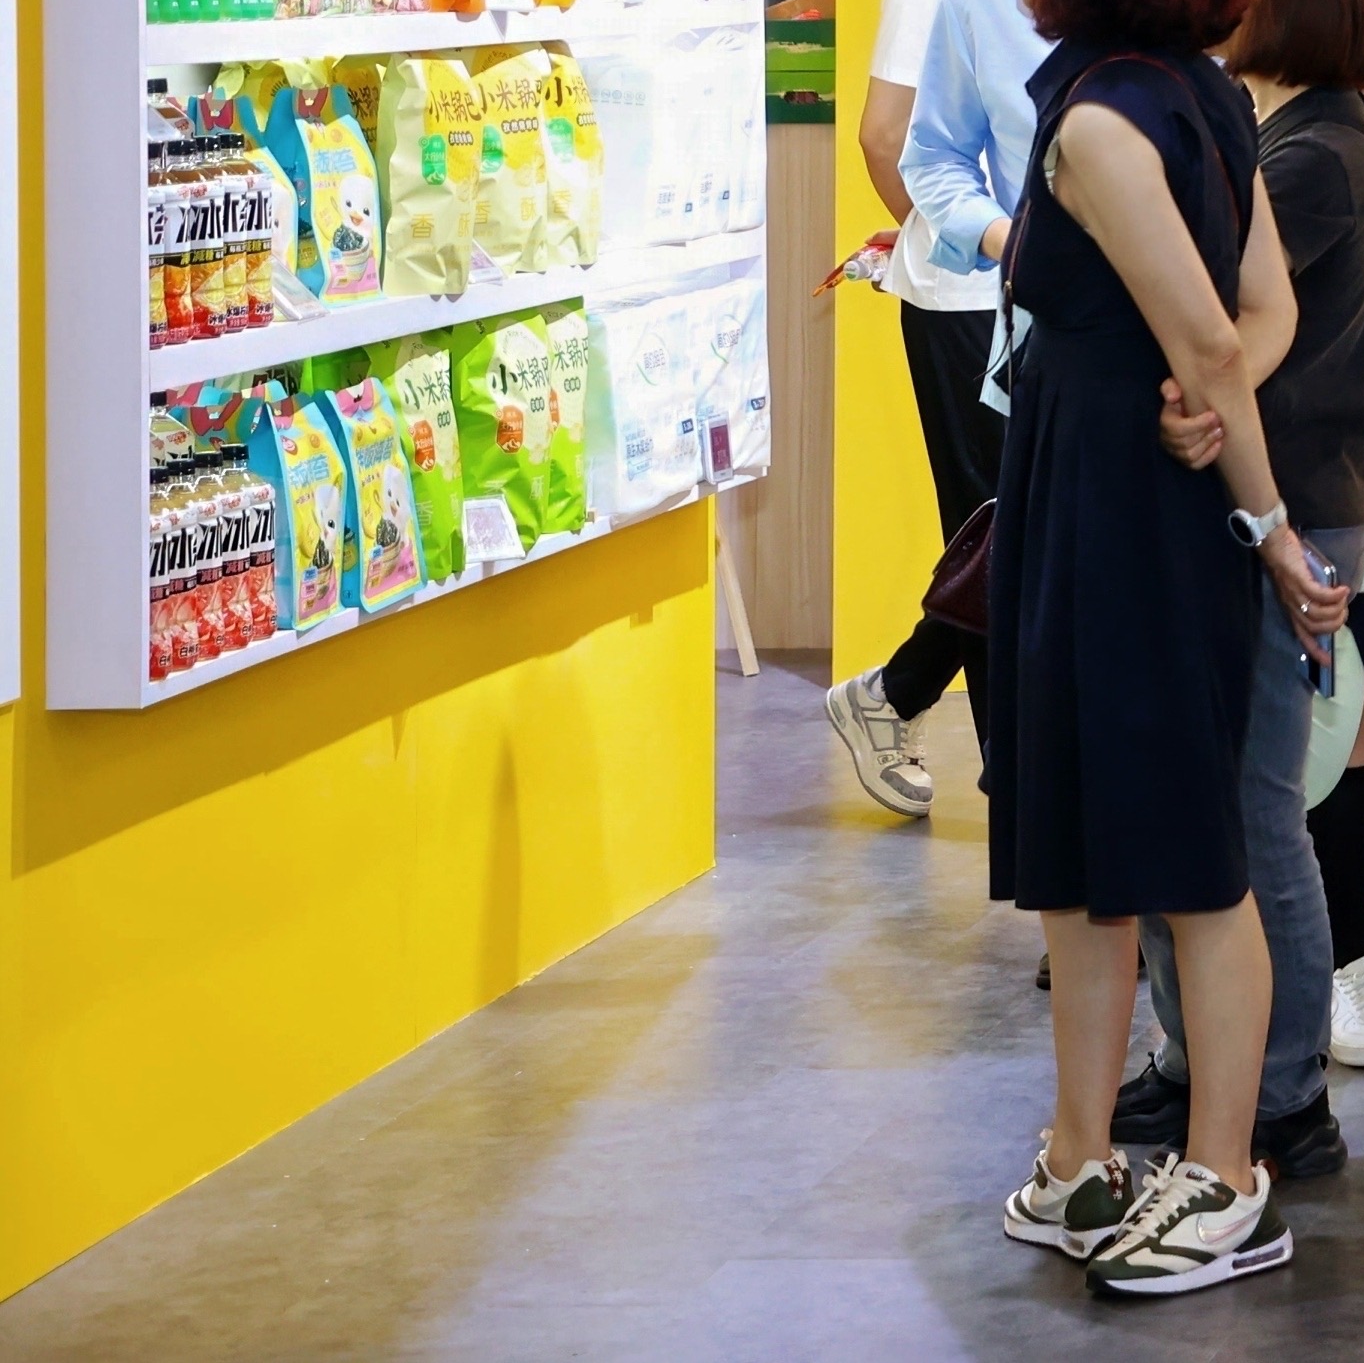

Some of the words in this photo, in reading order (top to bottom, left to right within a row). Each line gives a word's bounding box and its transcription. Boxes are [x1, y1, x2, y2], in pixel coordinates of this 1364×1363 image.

[429, 89, 481, 123] 小米锅巴
[411, 214, 435, 239] 香
